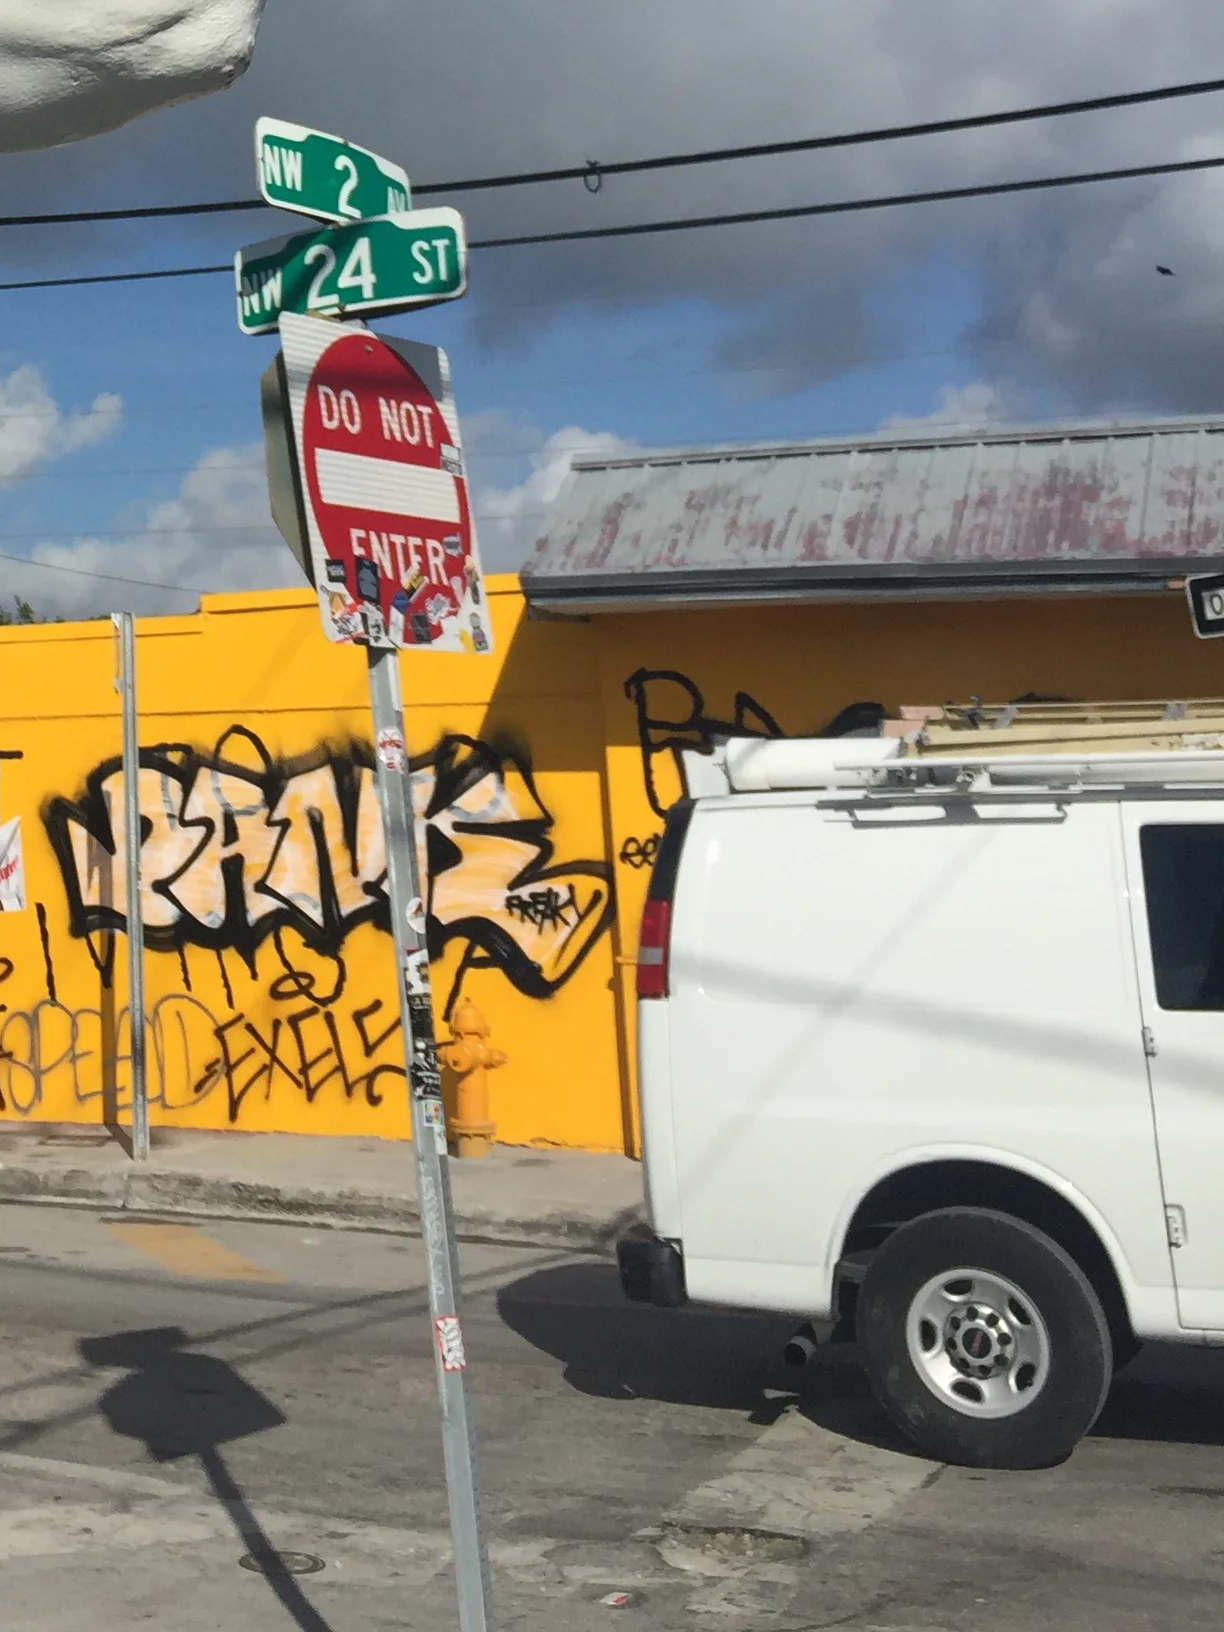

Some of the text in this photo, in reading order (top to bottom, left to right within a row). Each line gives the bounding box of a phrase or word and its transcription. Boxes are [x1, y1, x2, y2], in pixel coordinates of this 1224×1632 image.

[263, 144, 302, 192] NW
[334, 155, 362, 219] 2
[242, 237, 450, 317] NW 24 ST
[317, 384, 434, 448] DO NOT
[349, 528, 450, 586] ENTER
